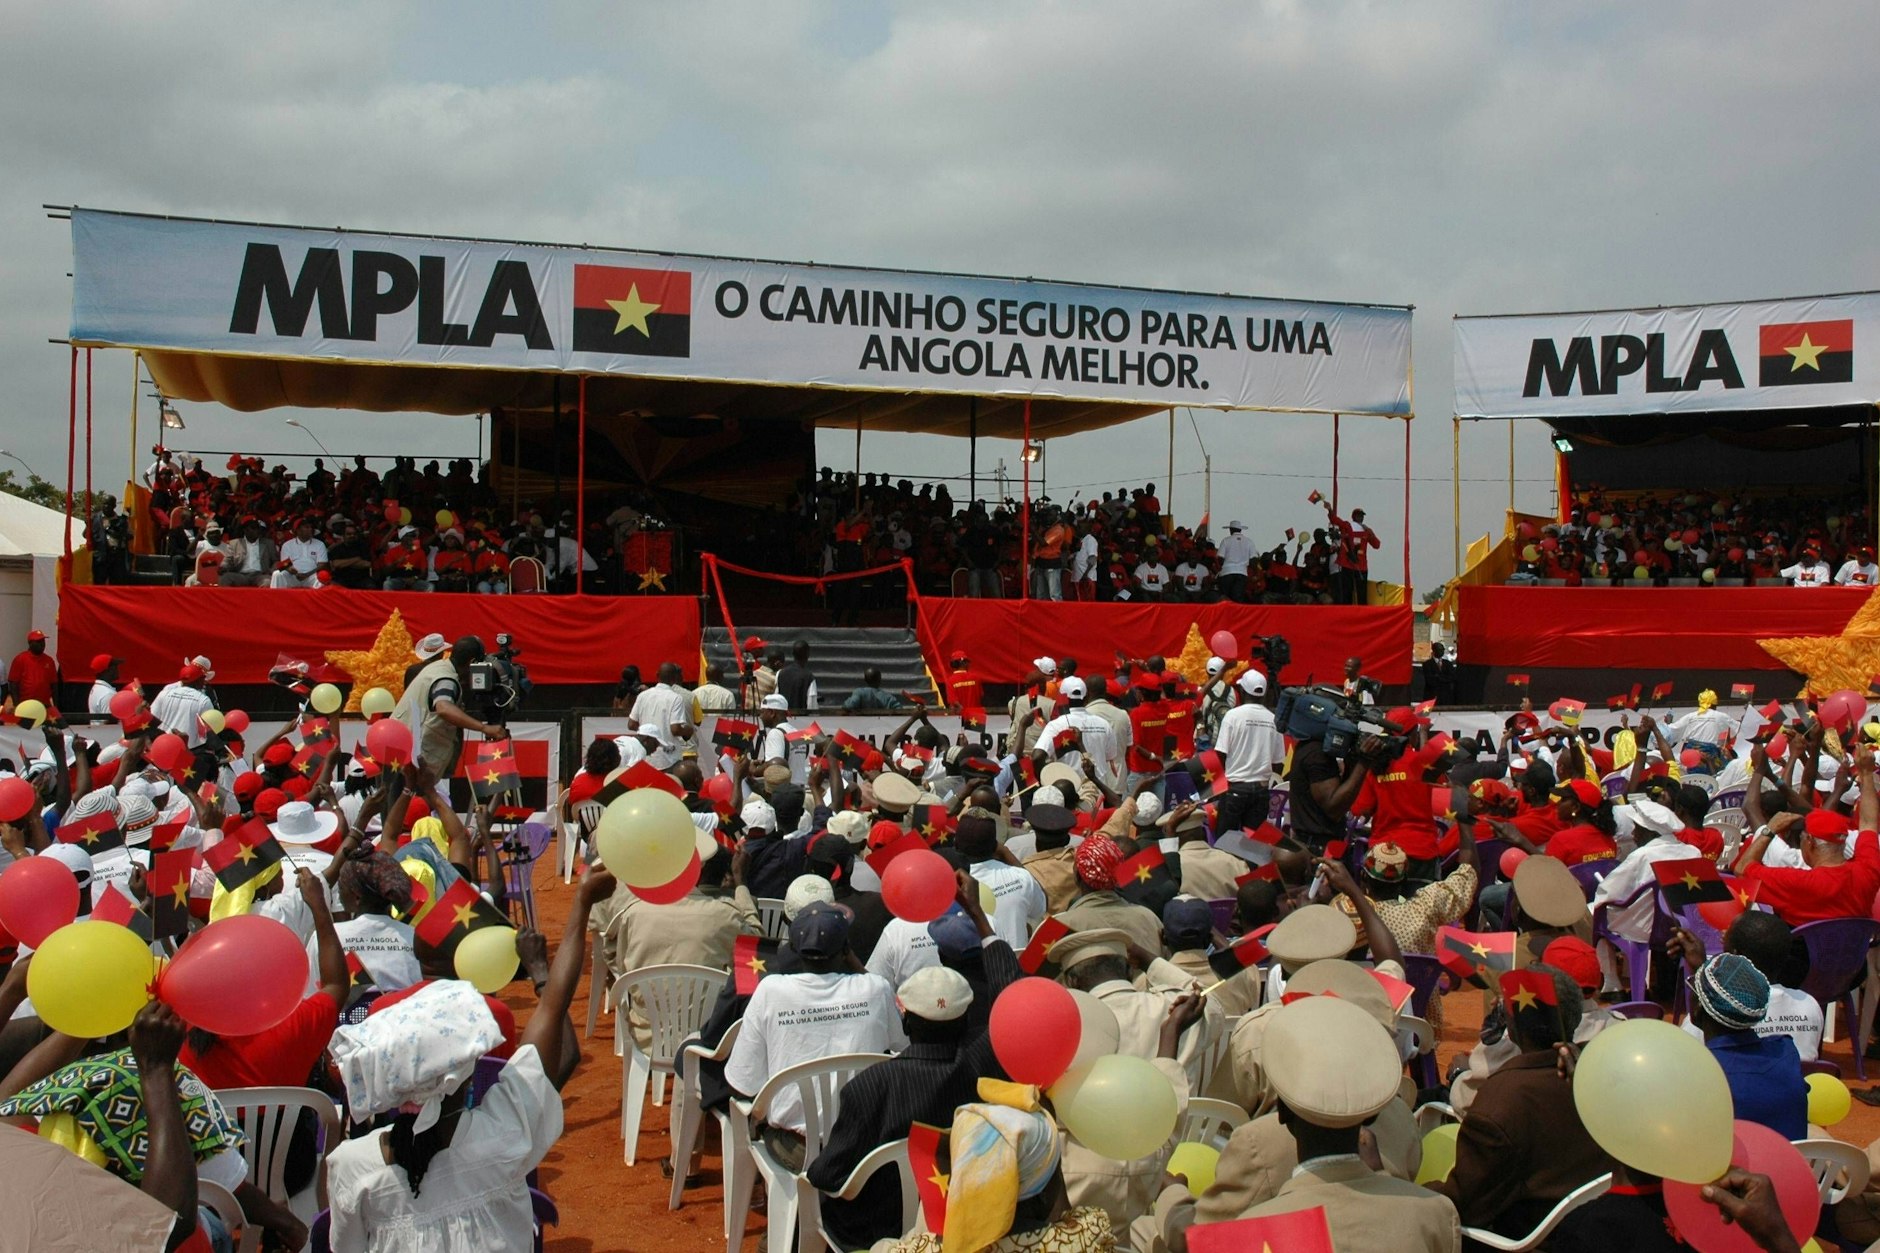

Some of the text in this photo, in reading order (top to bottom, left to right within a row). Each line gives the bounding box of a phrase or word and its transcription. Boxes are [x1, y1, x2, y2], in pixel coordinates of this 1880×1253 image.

[229, 242, 555, 350] MPLA
[715, 281, 1333, 356] O CAMINHO SEGURO PARA UMA
[859, 335, 1210, 391] ANGOLA MELHOR.
[1523, 329, 1745, 398] MPLA
[807, 1005, 840, 1014] CAMINHO
[841, 1001, 869, 1010] SEGURO
[813, 1014, 841, 1022] ANGOLA
[842, 1010, 870, 1019] MELHOR
